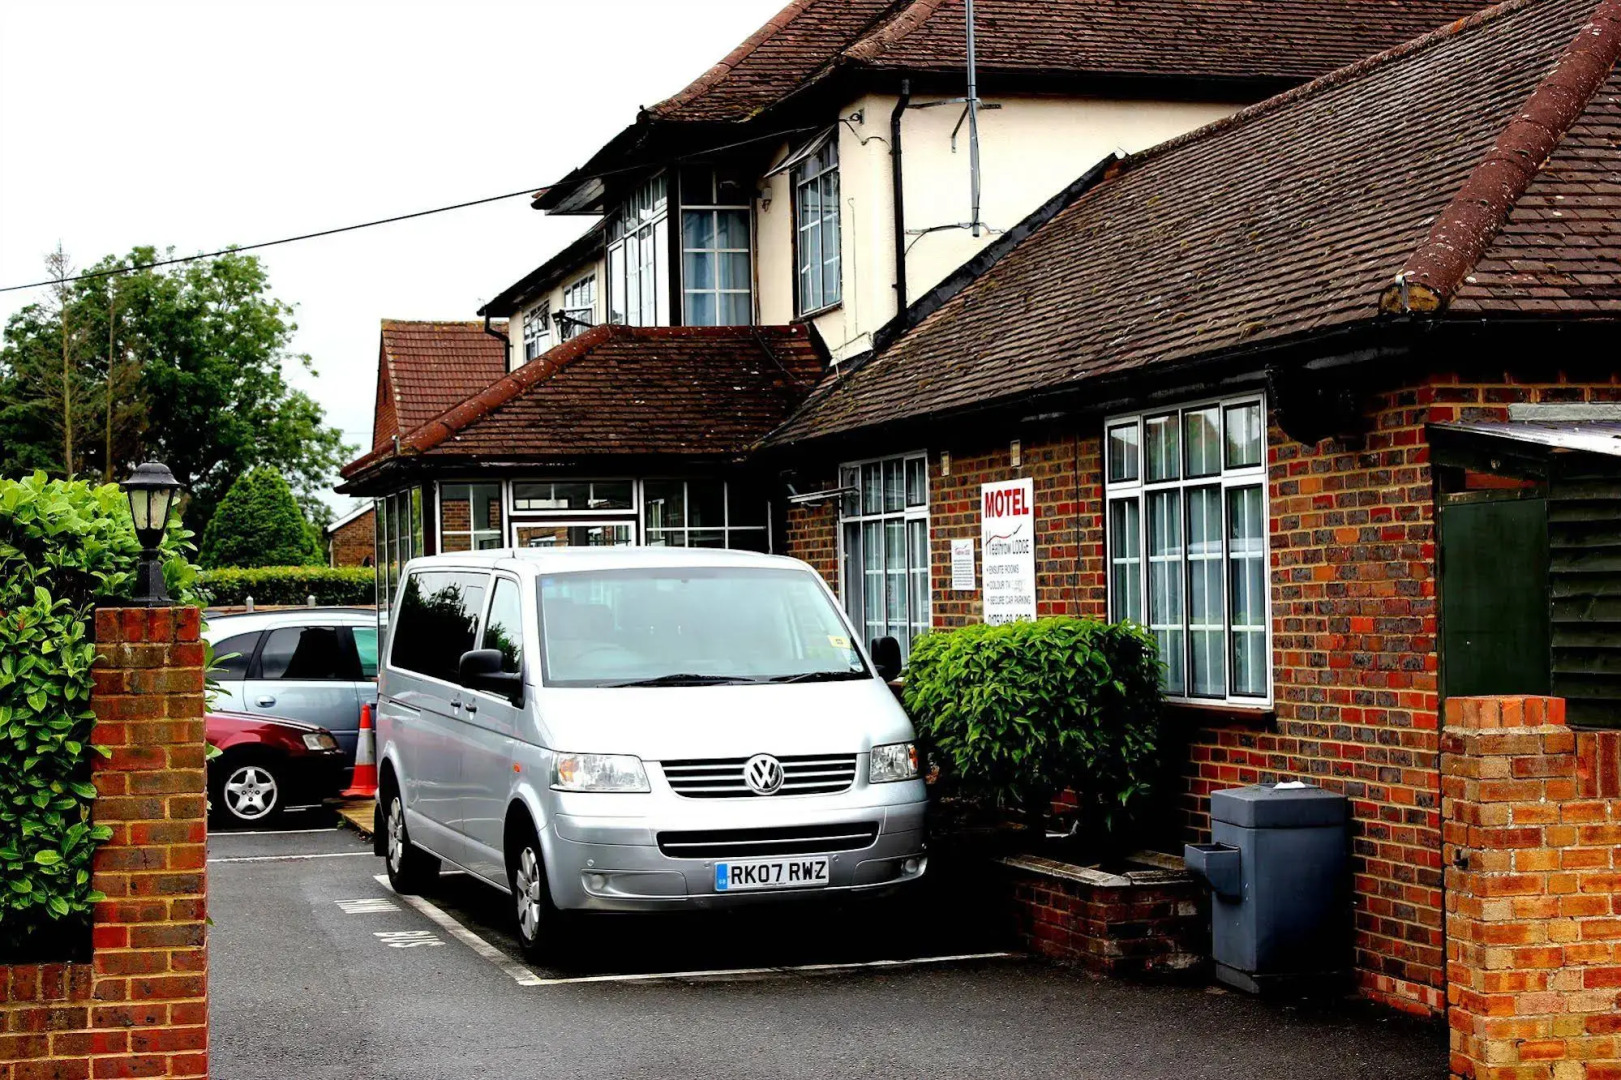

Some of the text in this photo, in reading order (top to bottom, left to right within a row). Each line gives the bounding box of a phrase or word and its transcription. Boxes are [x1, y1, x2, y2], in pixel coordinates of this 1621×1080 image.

[985, 488, 1029, 518] MOTEL
[986, 530, 1011, 556] Heathrow
[1012, 539, 1029, 554] LODGE
[988, 564, 1020, 575] ENSUITE ROOMS
[989, 580, 1005, 590] COLOUR
[990, 595, 1031, 605] SECURE CAR PARKING
[731, 861, 827, 885] RK07 RWZ
[372, 930, 447, 948] BUS
